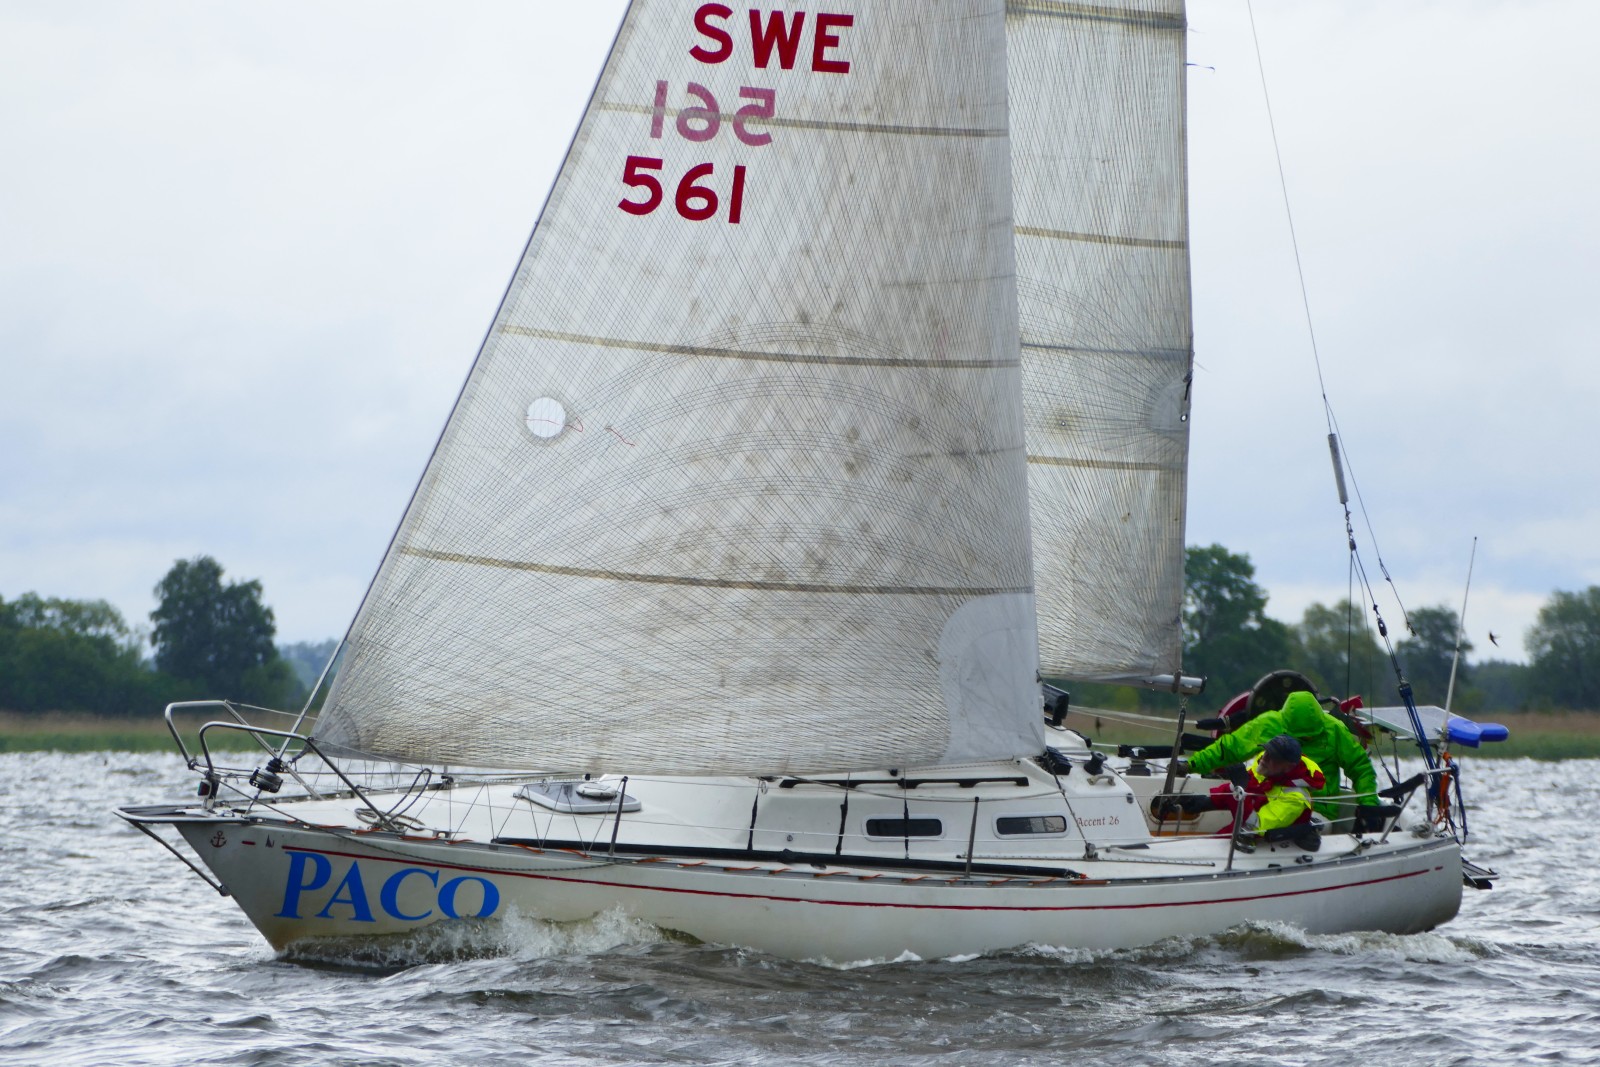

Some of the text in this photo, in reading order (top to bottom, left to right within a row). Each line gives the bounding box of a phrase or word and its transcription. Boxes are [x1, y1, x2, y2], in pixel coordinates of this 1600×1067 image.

[689, 3, 854, 74] SWE
[618, 155, 747, 224] 561
[1076, 815, 1120, 827] Accent 26
[273, 851, 500, 922] PACO
